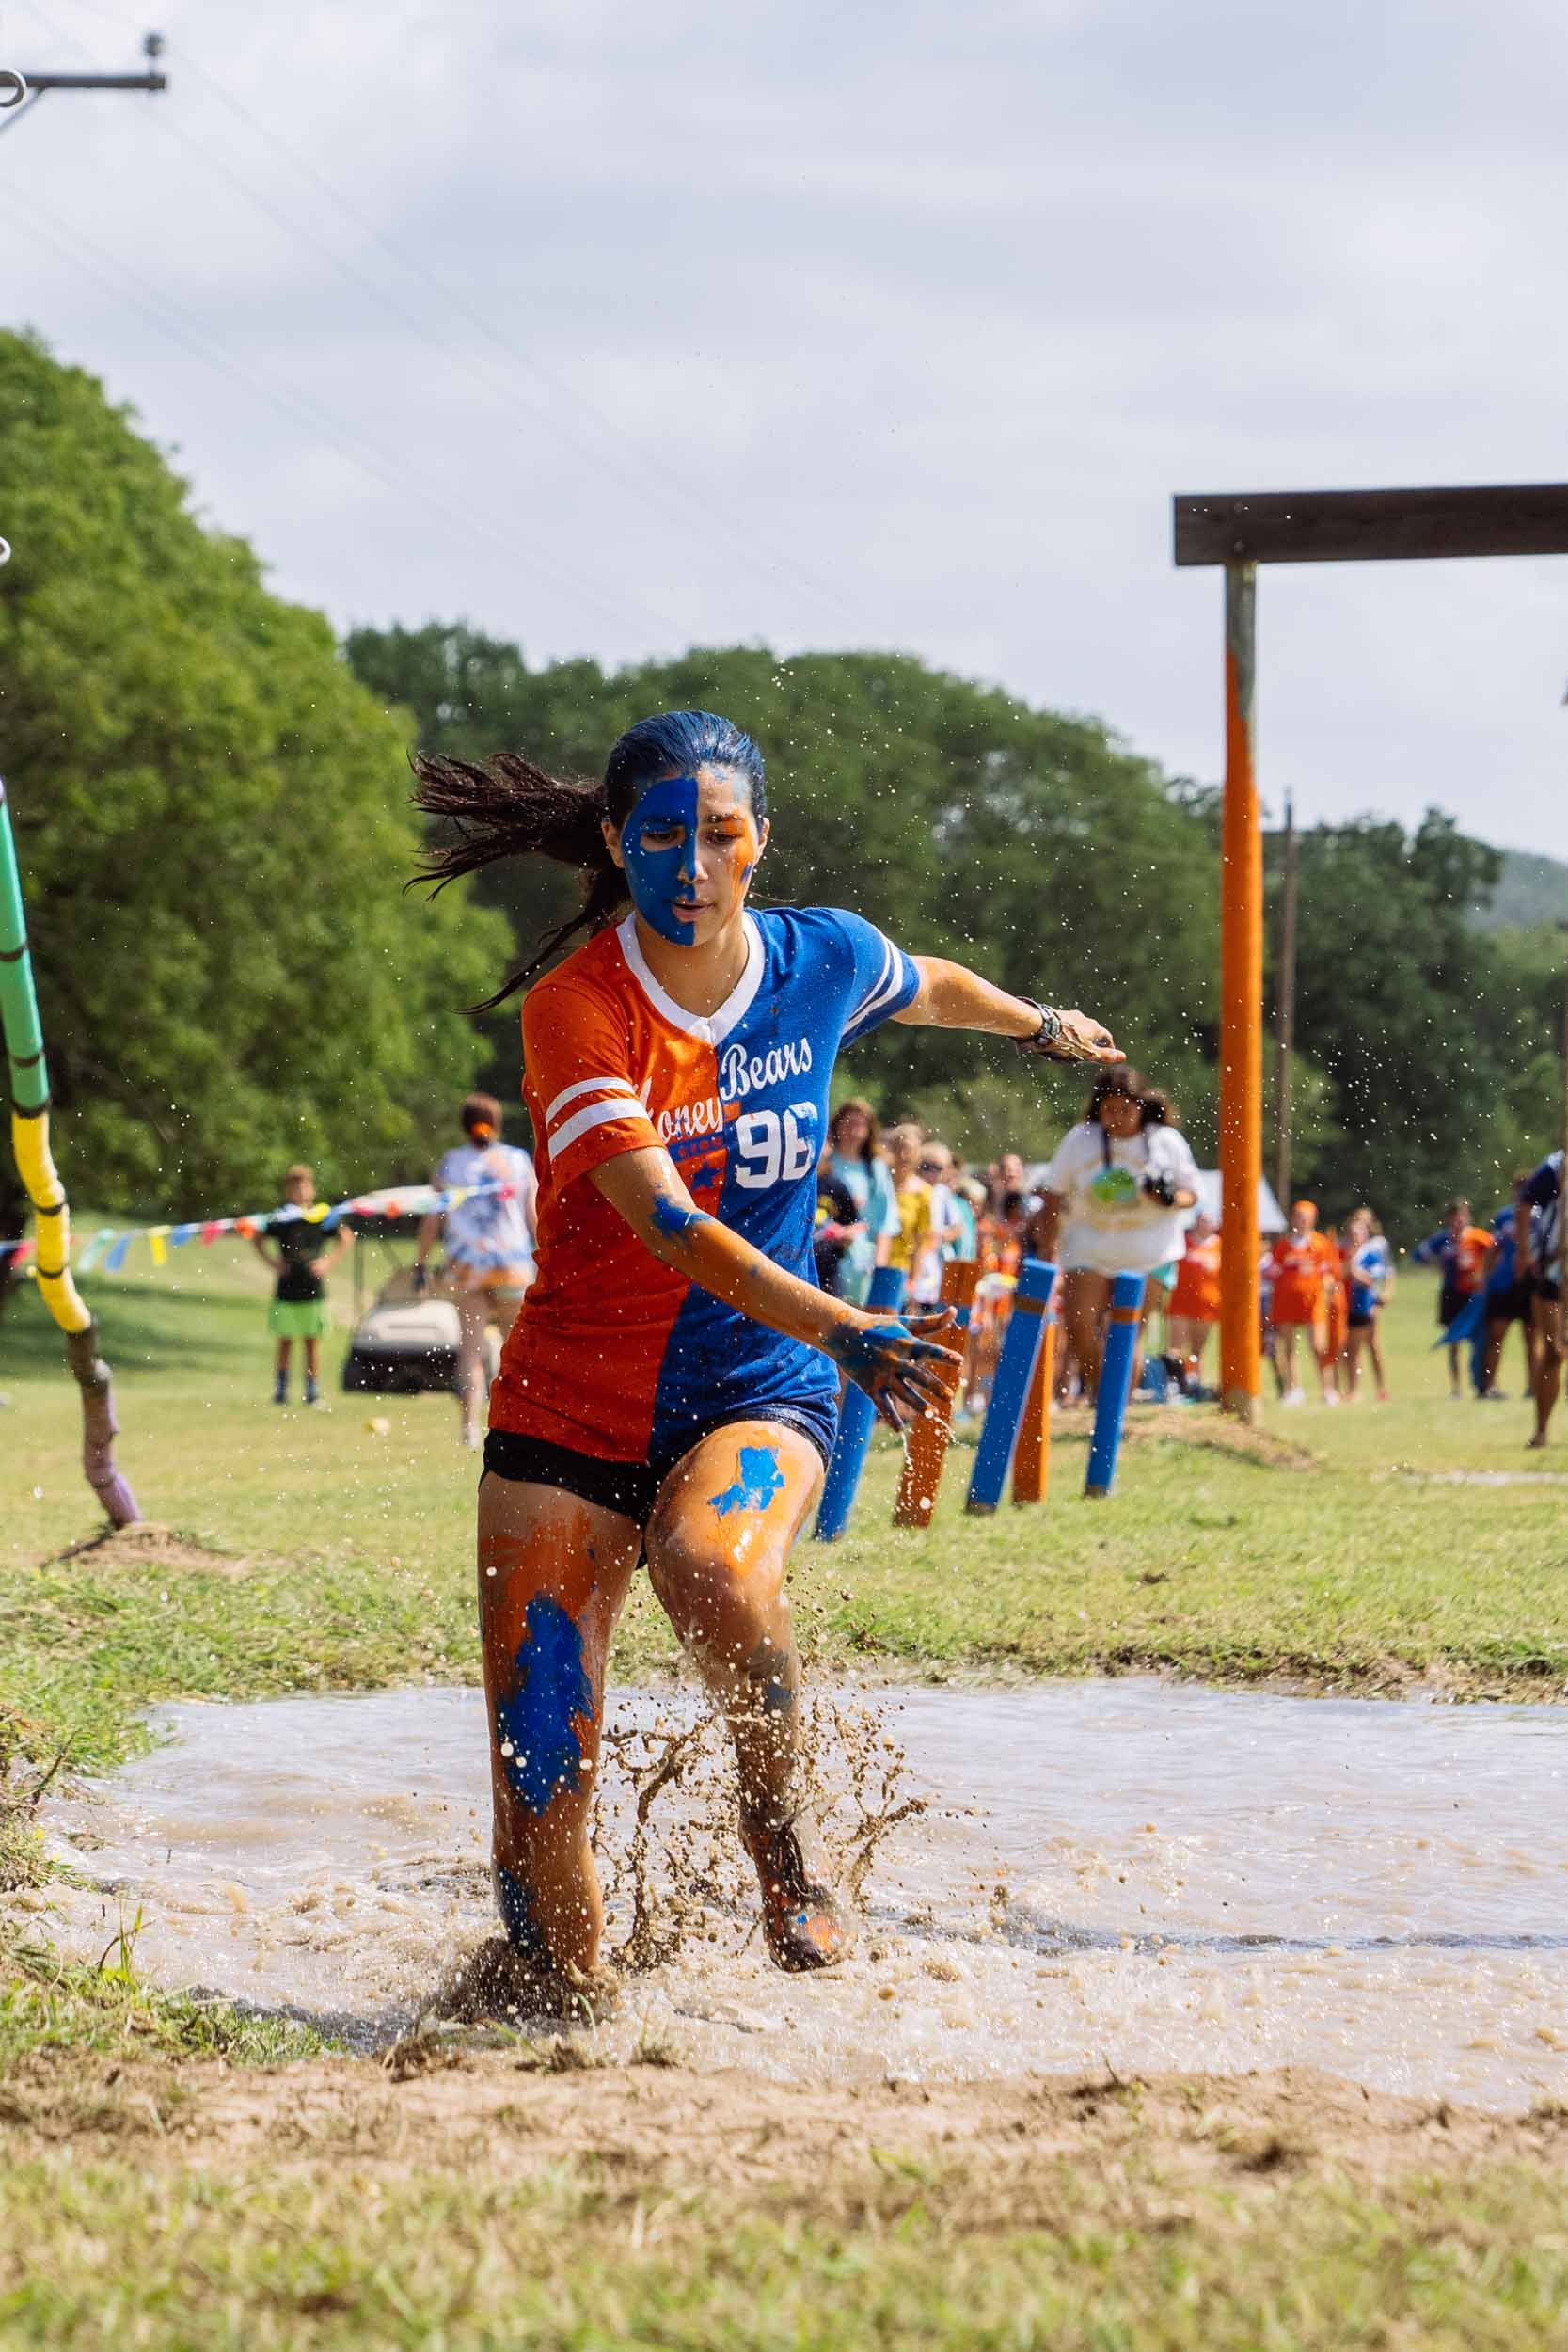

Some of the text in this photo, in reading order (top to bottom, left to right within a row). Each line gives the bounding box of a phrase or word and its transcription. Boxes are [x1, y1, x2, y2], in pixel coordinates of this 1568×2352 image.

[640, 1038, 812, 1144] oney Bears
[736, 1101, 818, 1188] 96
